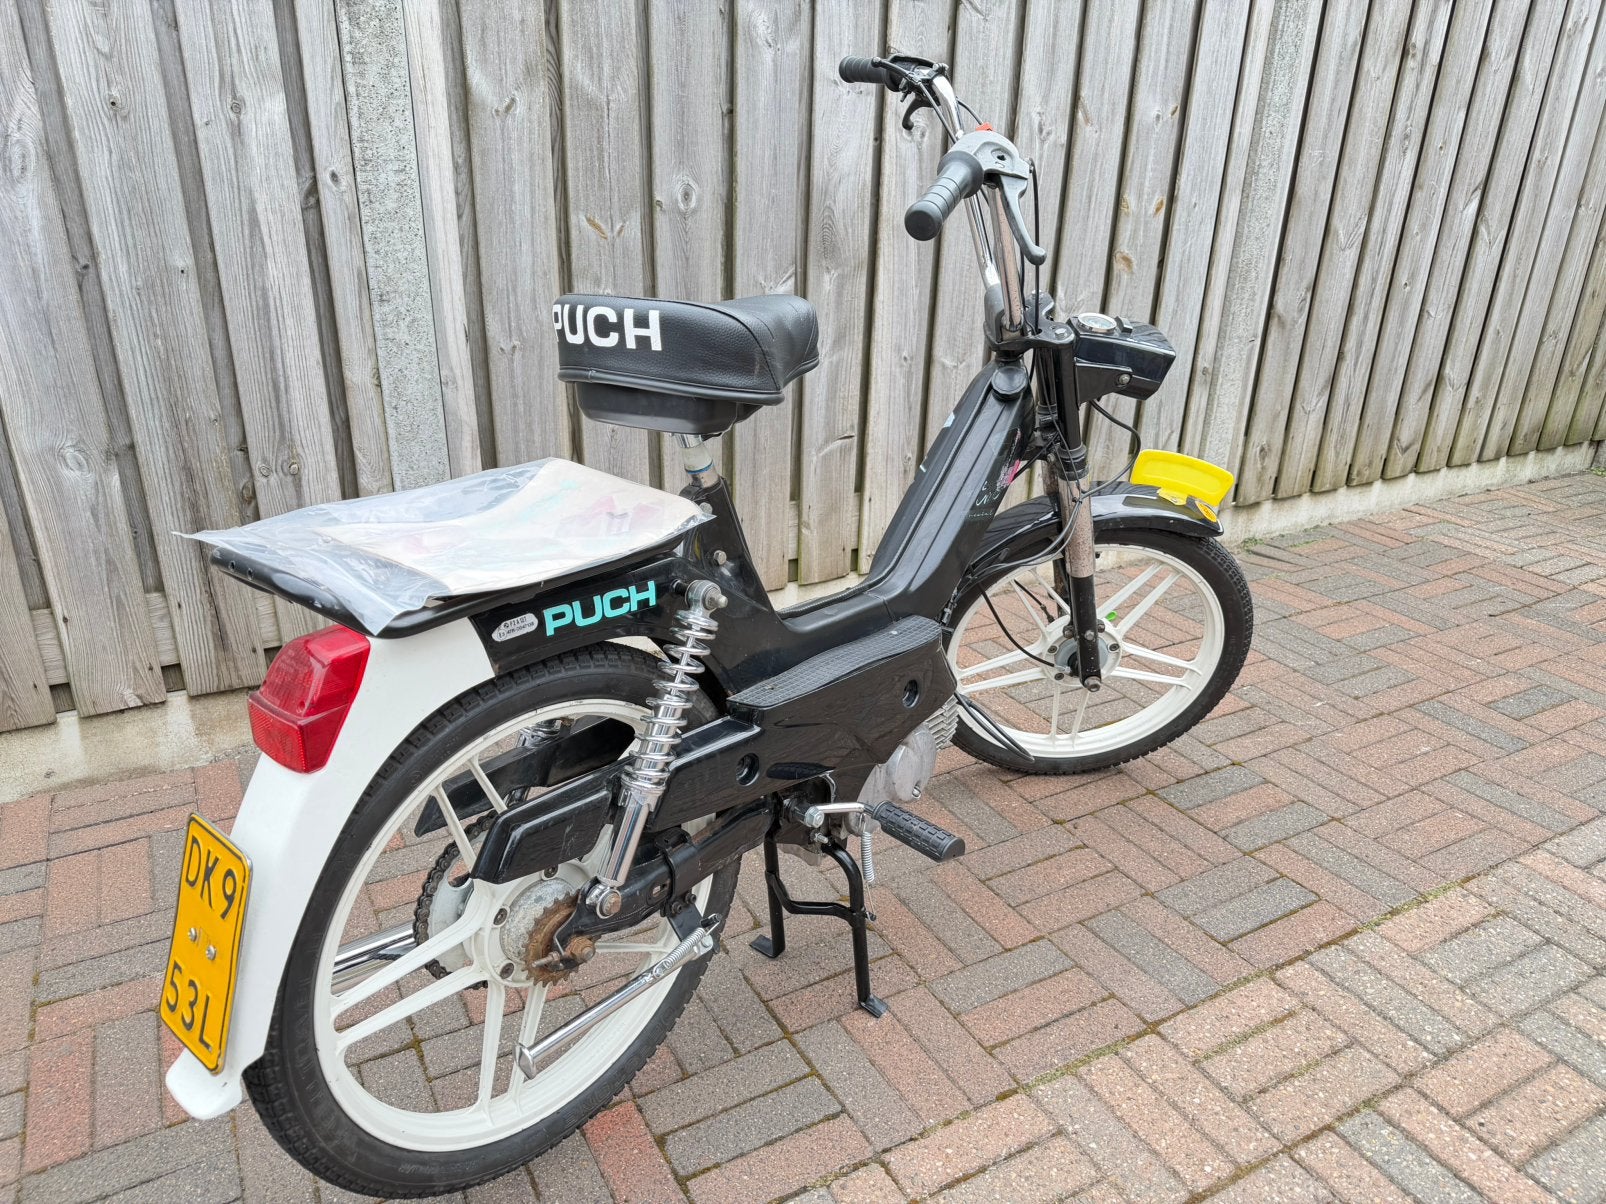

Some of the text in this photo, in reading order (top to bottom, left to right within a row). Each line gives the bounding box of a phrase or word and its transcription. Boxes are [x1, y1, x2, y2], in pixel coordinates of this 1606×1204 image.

[552, 303, 663, 351] PUCH
[543, 580, 657, 637] PUCH
[185, 834, 238, 920] DK9
[165, 959, 213, 1052] 53L
